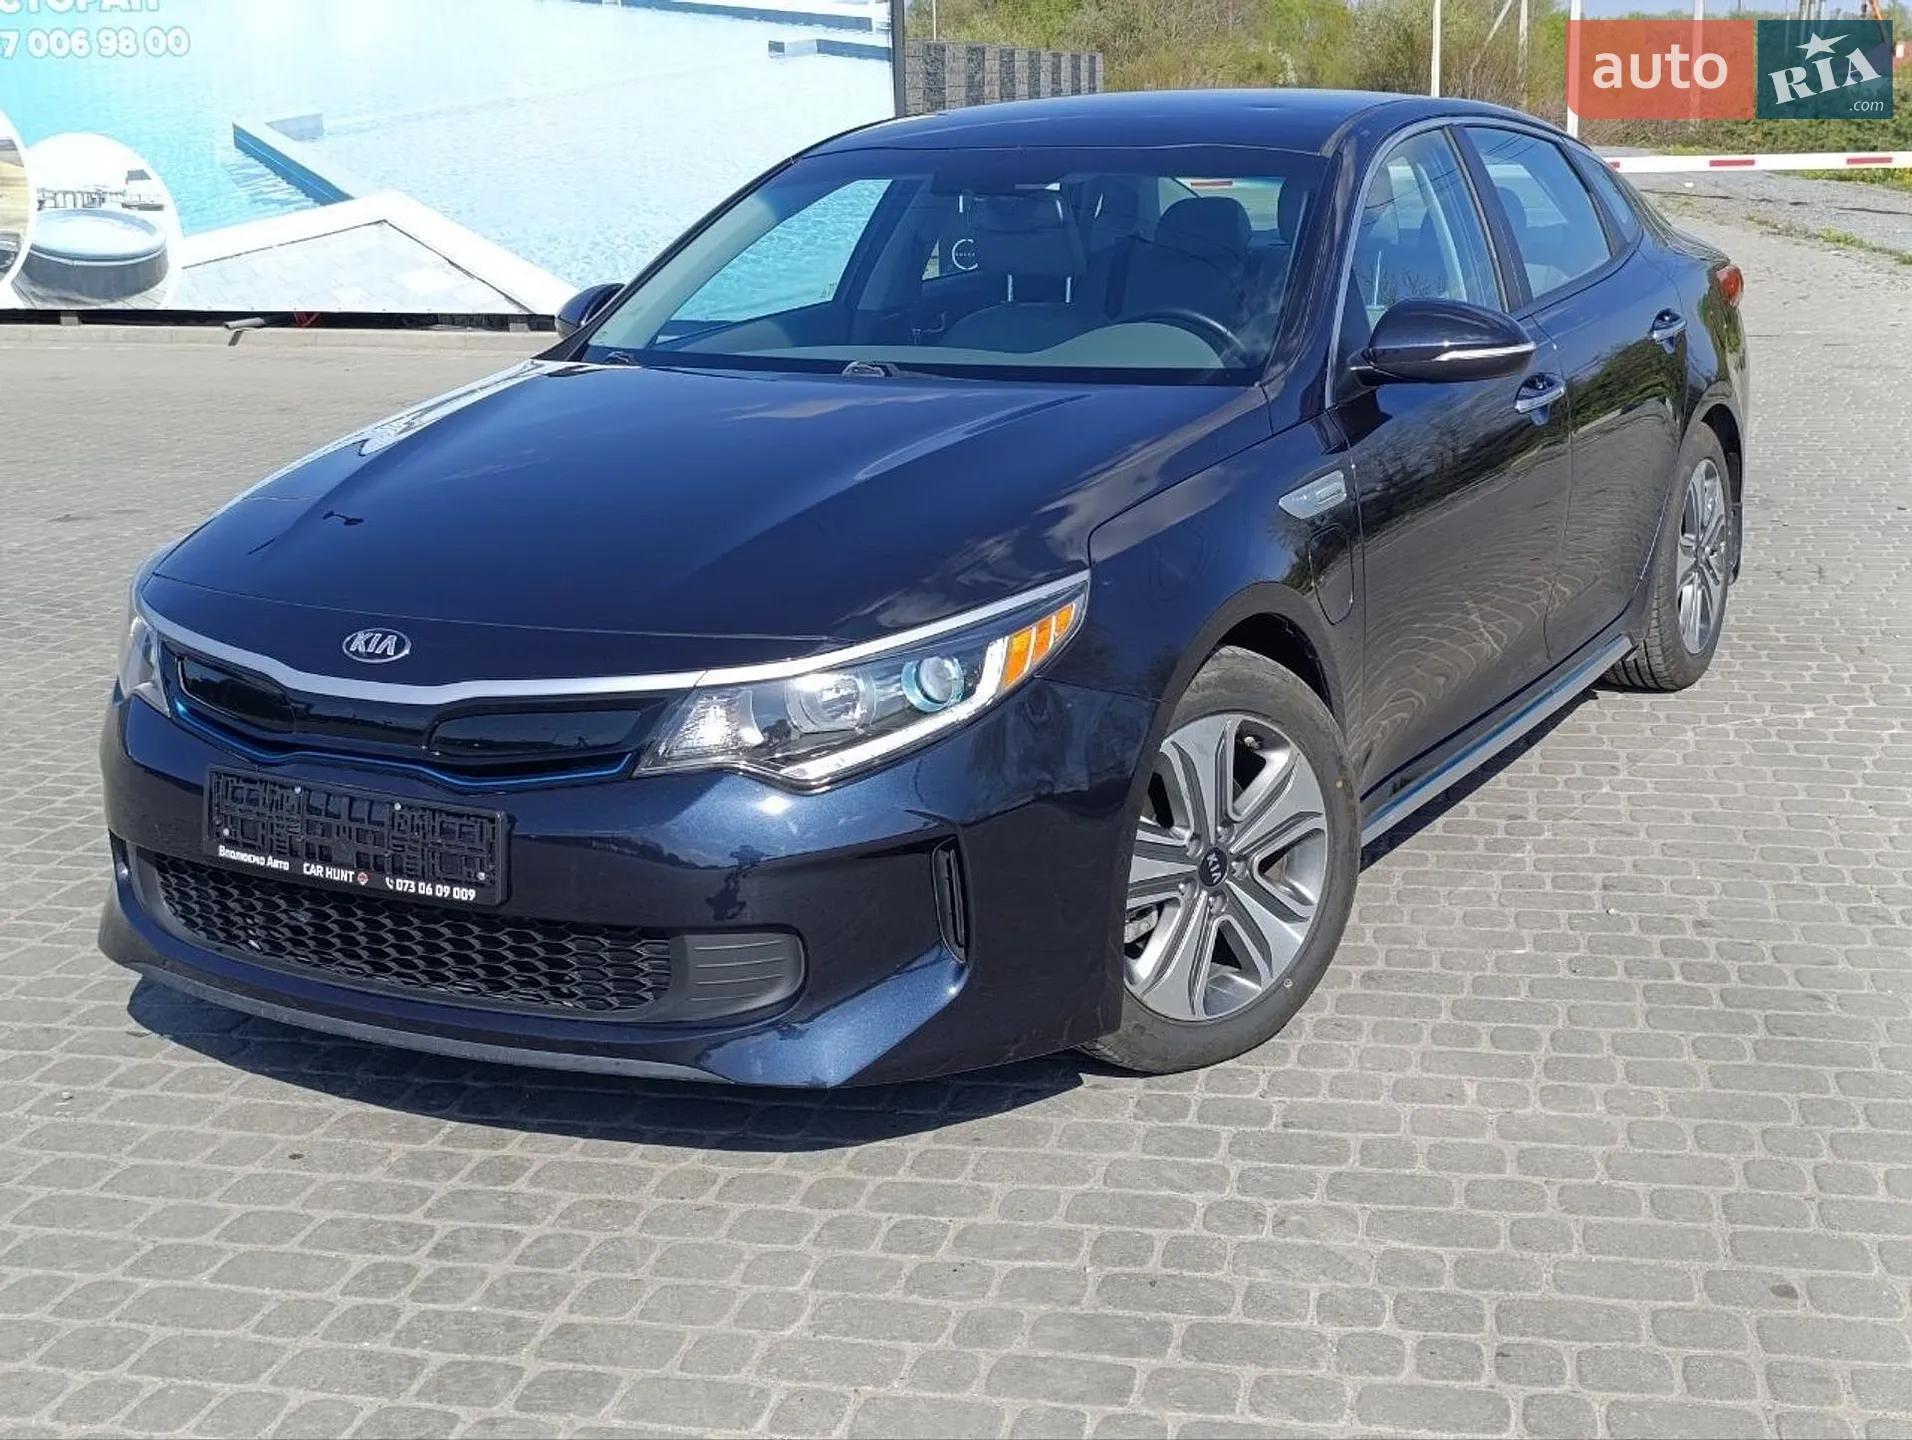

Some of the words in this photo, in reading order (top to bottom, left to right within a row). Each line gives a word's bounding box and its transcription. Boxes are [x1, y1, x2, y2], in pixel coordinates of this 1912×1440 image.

[27, 27, 92, 59] 006
[97, 26, 139, 58] 98
[144, 25, 191, 57] 00
[349, 631, 398, 656] KIA
[302, 862, 325, 878] CAR
[325, 867, 355, 883] HUNT
[395, 878, 416, 893] 073
[418, 881, 433, 896] 06
[435, 884, 451, 898] 09
[452, 887, 477, 901] 009
